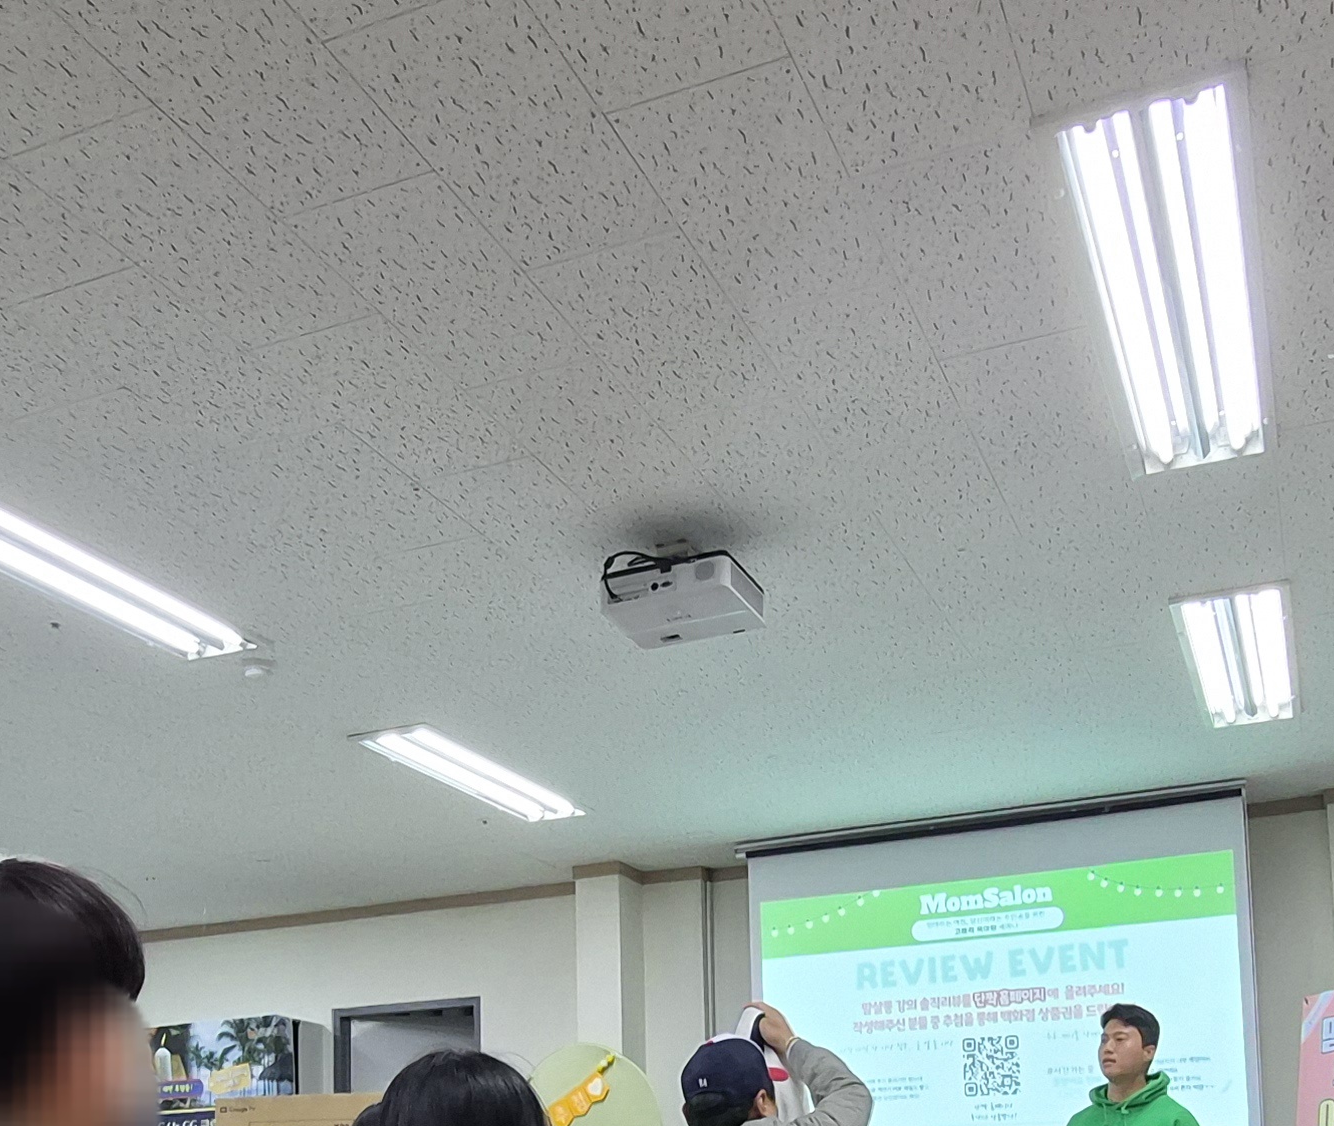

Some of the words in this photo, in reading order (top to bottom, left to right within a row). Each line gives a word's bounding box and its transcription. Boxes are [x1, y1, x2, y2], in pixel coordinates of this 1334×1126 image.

[919, 884, 1053, 915] MomSalon
[855, 950, 994, 990] REVIEW
[1008, 938, 1129, 978] EVENT
